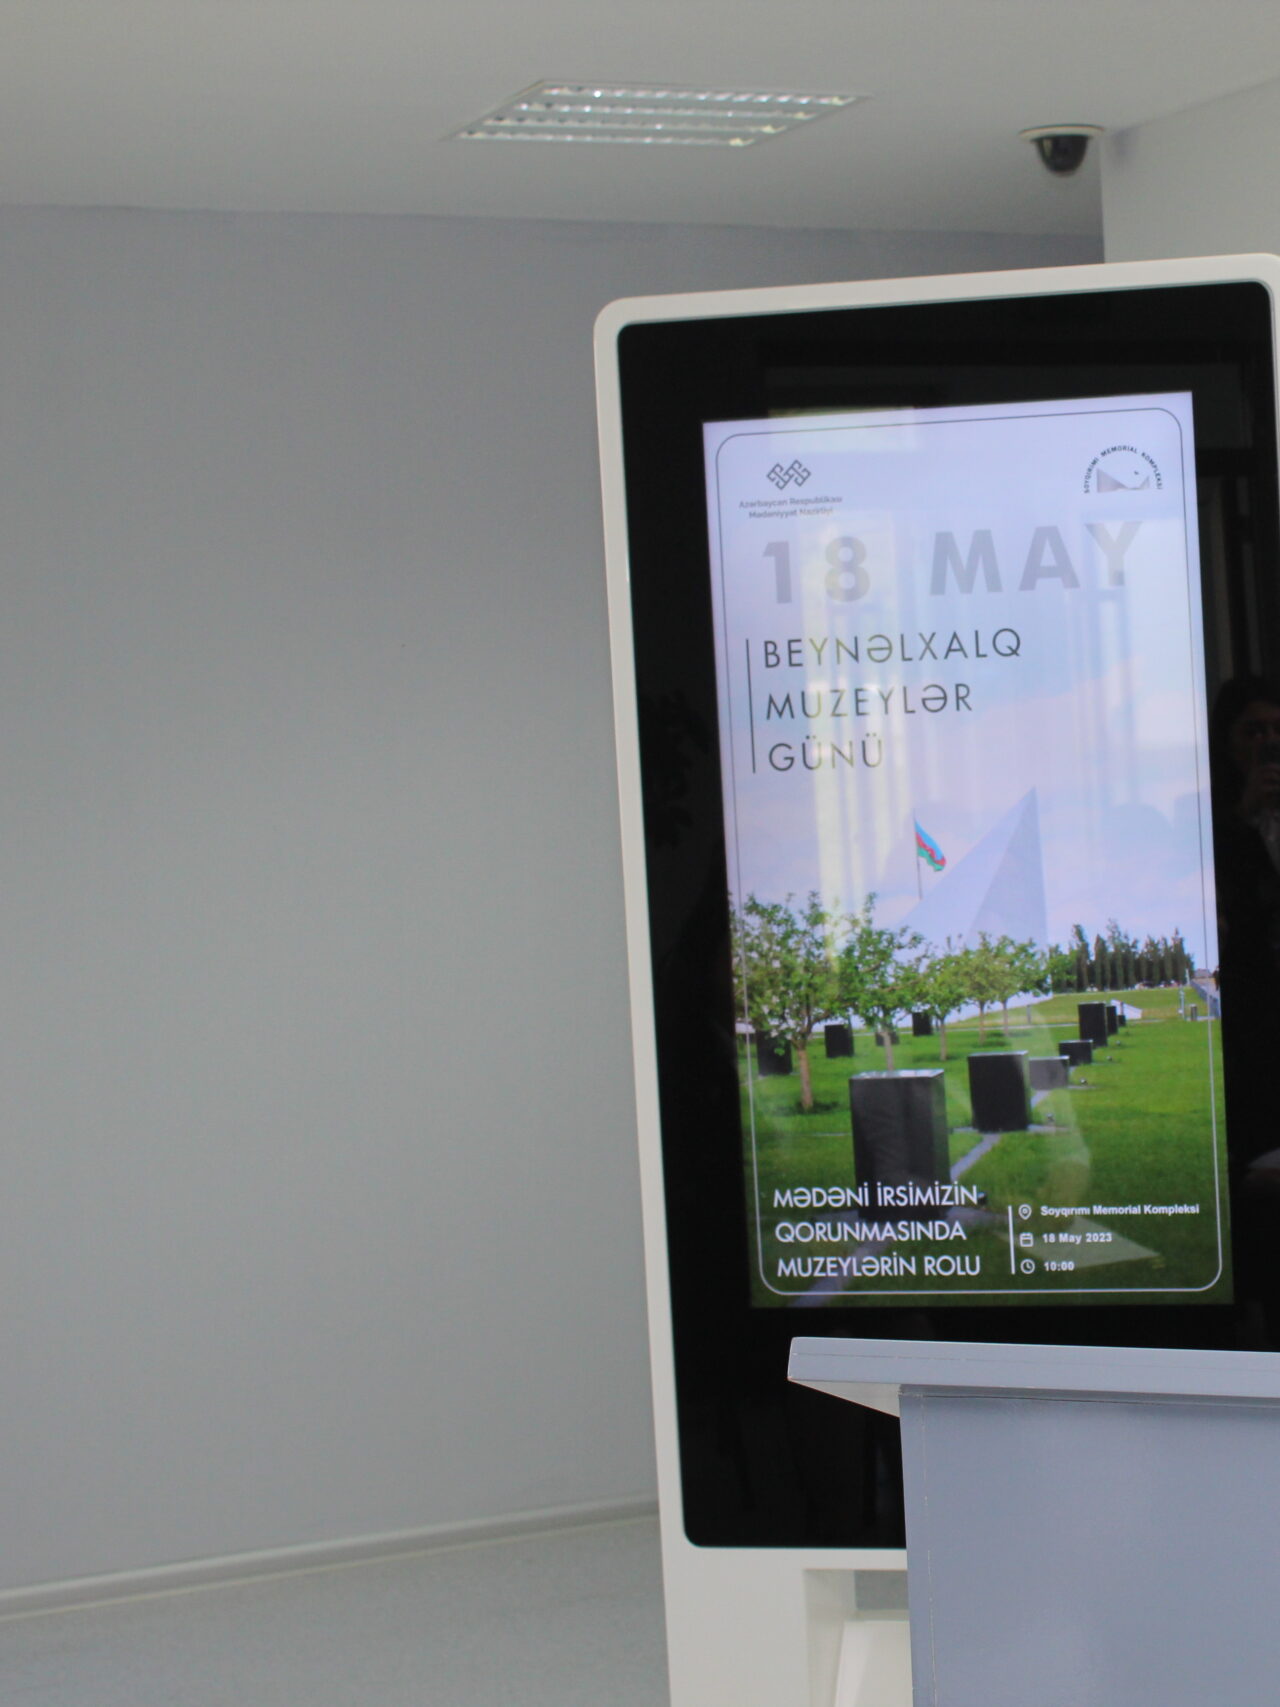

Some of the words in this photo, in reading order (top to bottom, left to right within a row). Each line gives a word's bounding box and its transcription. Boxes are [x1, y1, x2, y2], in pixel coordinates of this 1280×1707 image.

[761, 535, 870, 605] 18
[929, 521, 1143, 597] MAY
[765, 628, 1023, 669] BEYNƏLXALQ
[766, 683, 973, 721] MUZEYLƏR
[768, 733, 885, 772] GÜNÜ
[773, 1183, 870, 1209] MƏDƏNİ
[876, 1180, 980, 1206] İRSİMİZİN
[1040, 1204, 1091, 1218] Soyqırımı
[1093, 1203, 1142, 1216] Memorial
[1143, 1202, 1200, 1217] Kompleksi
[774, 1221, 968, 1244] QORUNMASINDA
[1042, 1233, 1057, 1245] 18
[1058, 1232, 1083, 1246] May
[1085, 1232, 1113, 1244] 2023
[777, 1252, 917, 1278] MUZEYLƏRİN
[924, 1254, 982, 1277] ROLU
[1043, 1260, 1076, 1272] 10:00
